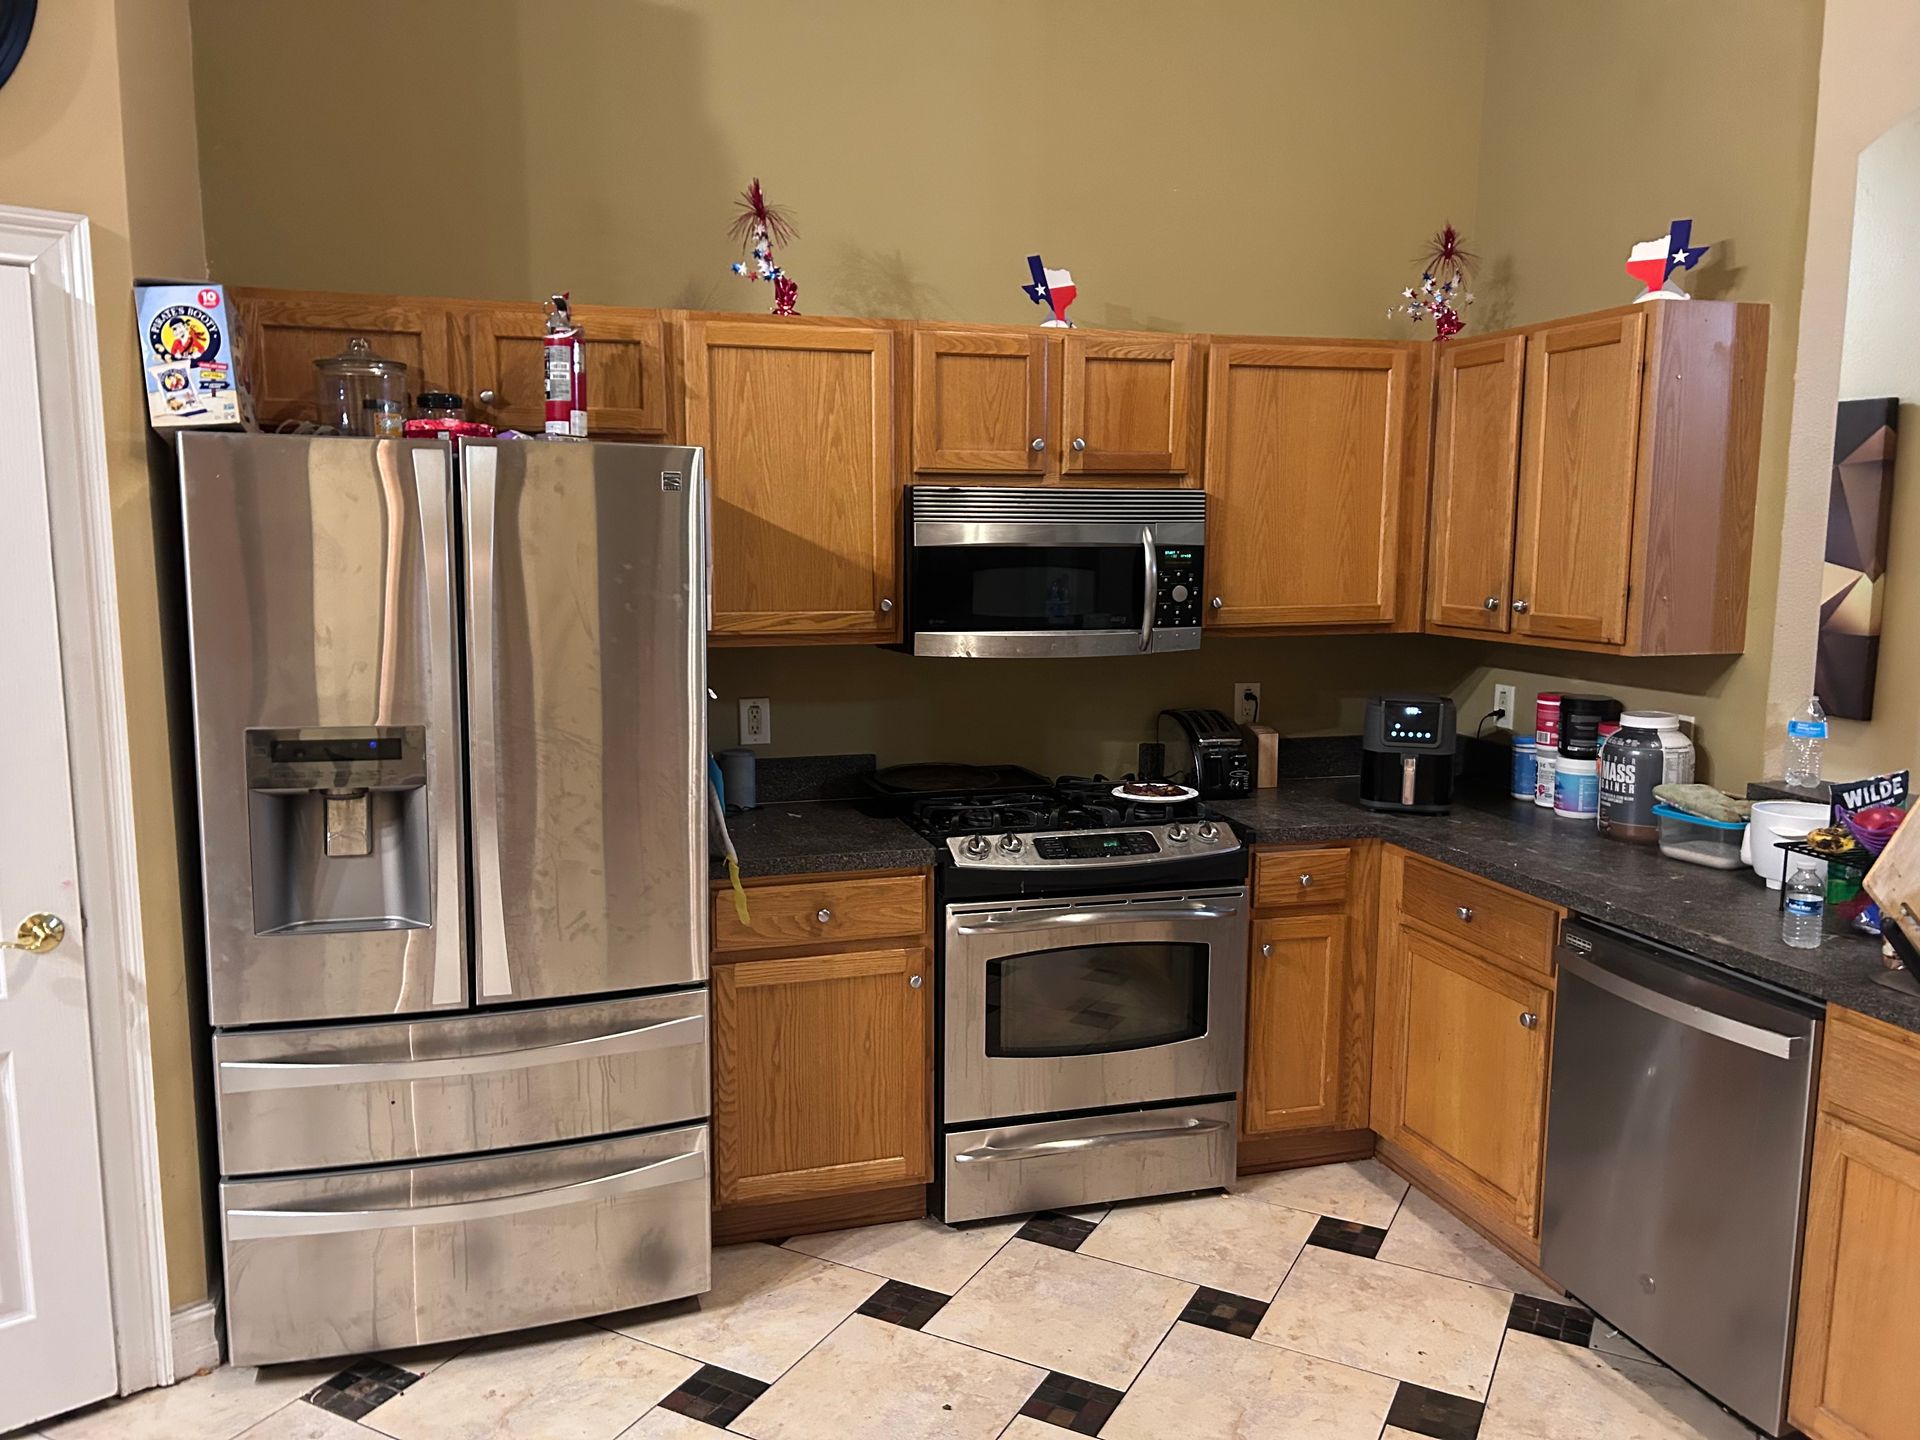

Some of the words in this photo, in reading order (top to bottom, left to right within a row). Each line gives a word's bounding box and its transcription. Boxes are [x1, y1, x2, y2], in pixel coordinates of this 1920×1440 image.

[201, 292, 217, 301] 10
[151, 307, 185, 333] PIRATE'S
[187, 308, 218, 333] BOOTY
[1602, 760, 1636, 784] MASS
[1842, 776, 1904, 809] WILDE
